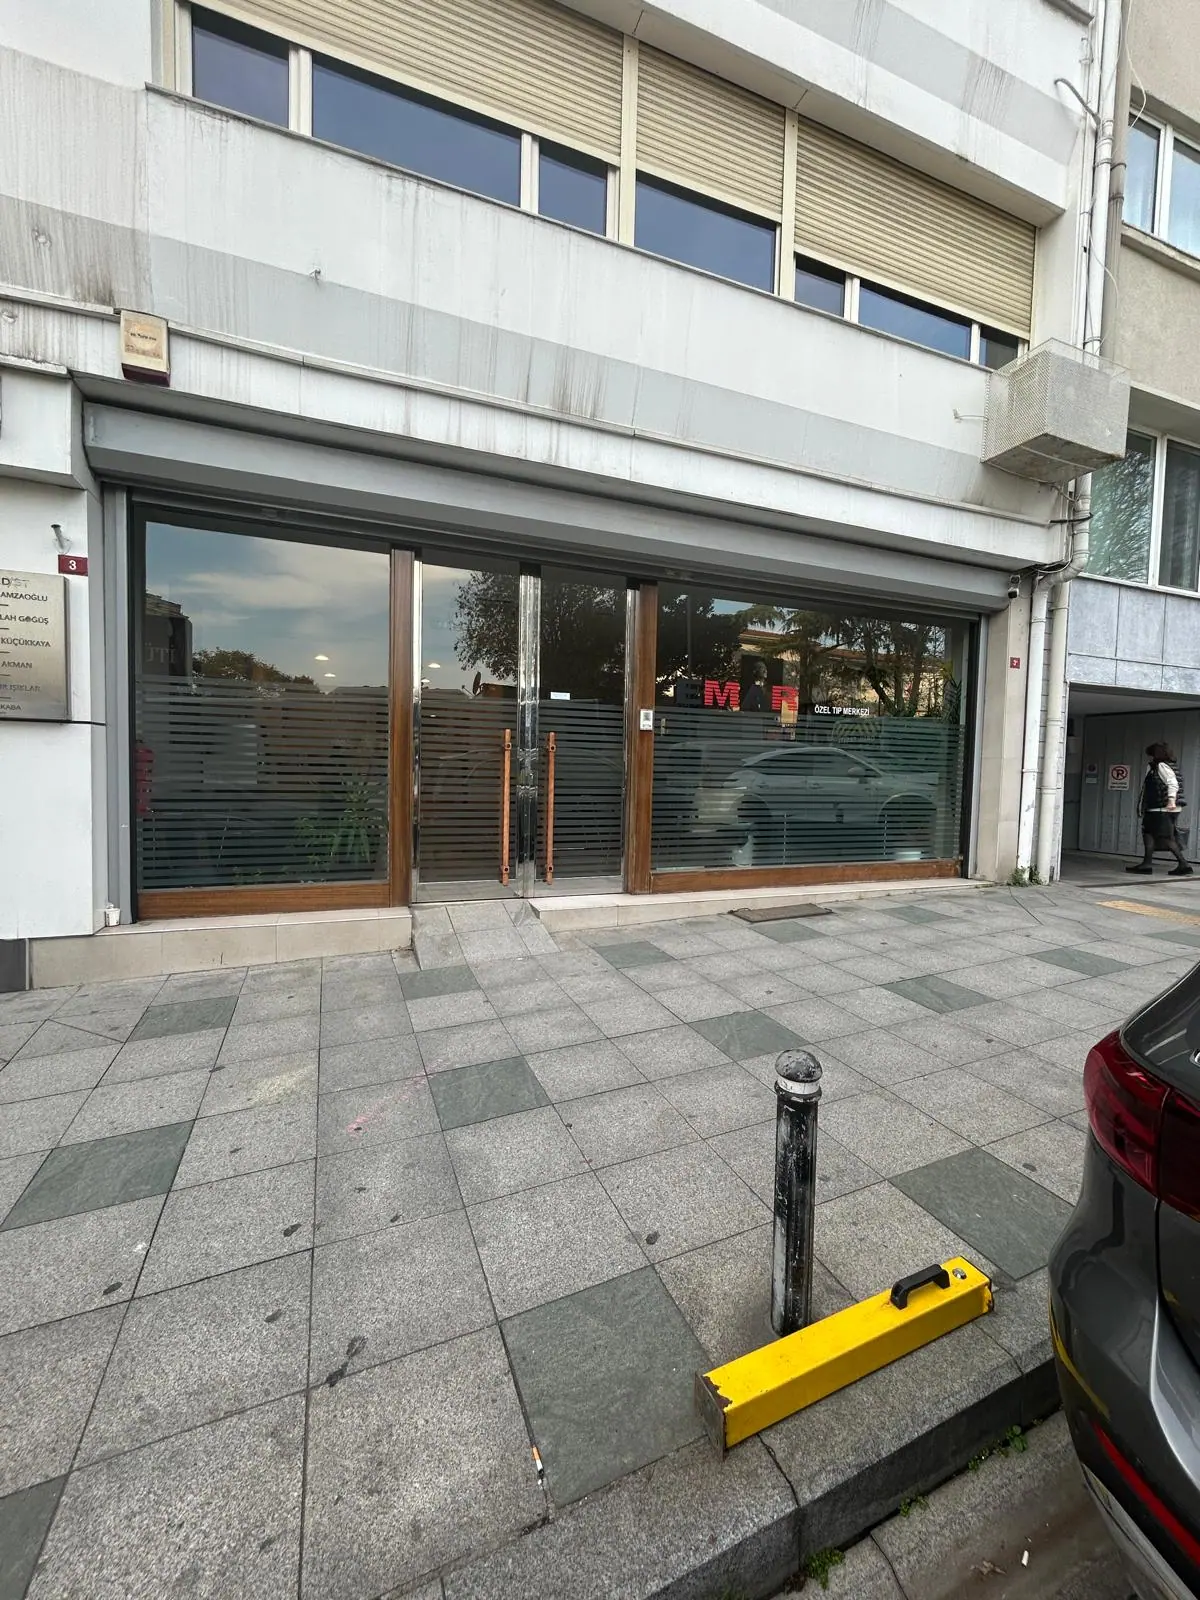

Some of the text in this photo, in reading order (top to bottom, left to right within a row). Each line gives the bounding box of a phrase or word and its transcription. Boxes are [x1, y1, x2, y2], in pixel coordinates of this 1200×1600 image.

[68, 559, 77, 571] 3
[1, 660, 33, 669] AKMAN
[814, 704, 831, 714] ÖZEL
[843, 706, 870, 716] MERKEZİ
